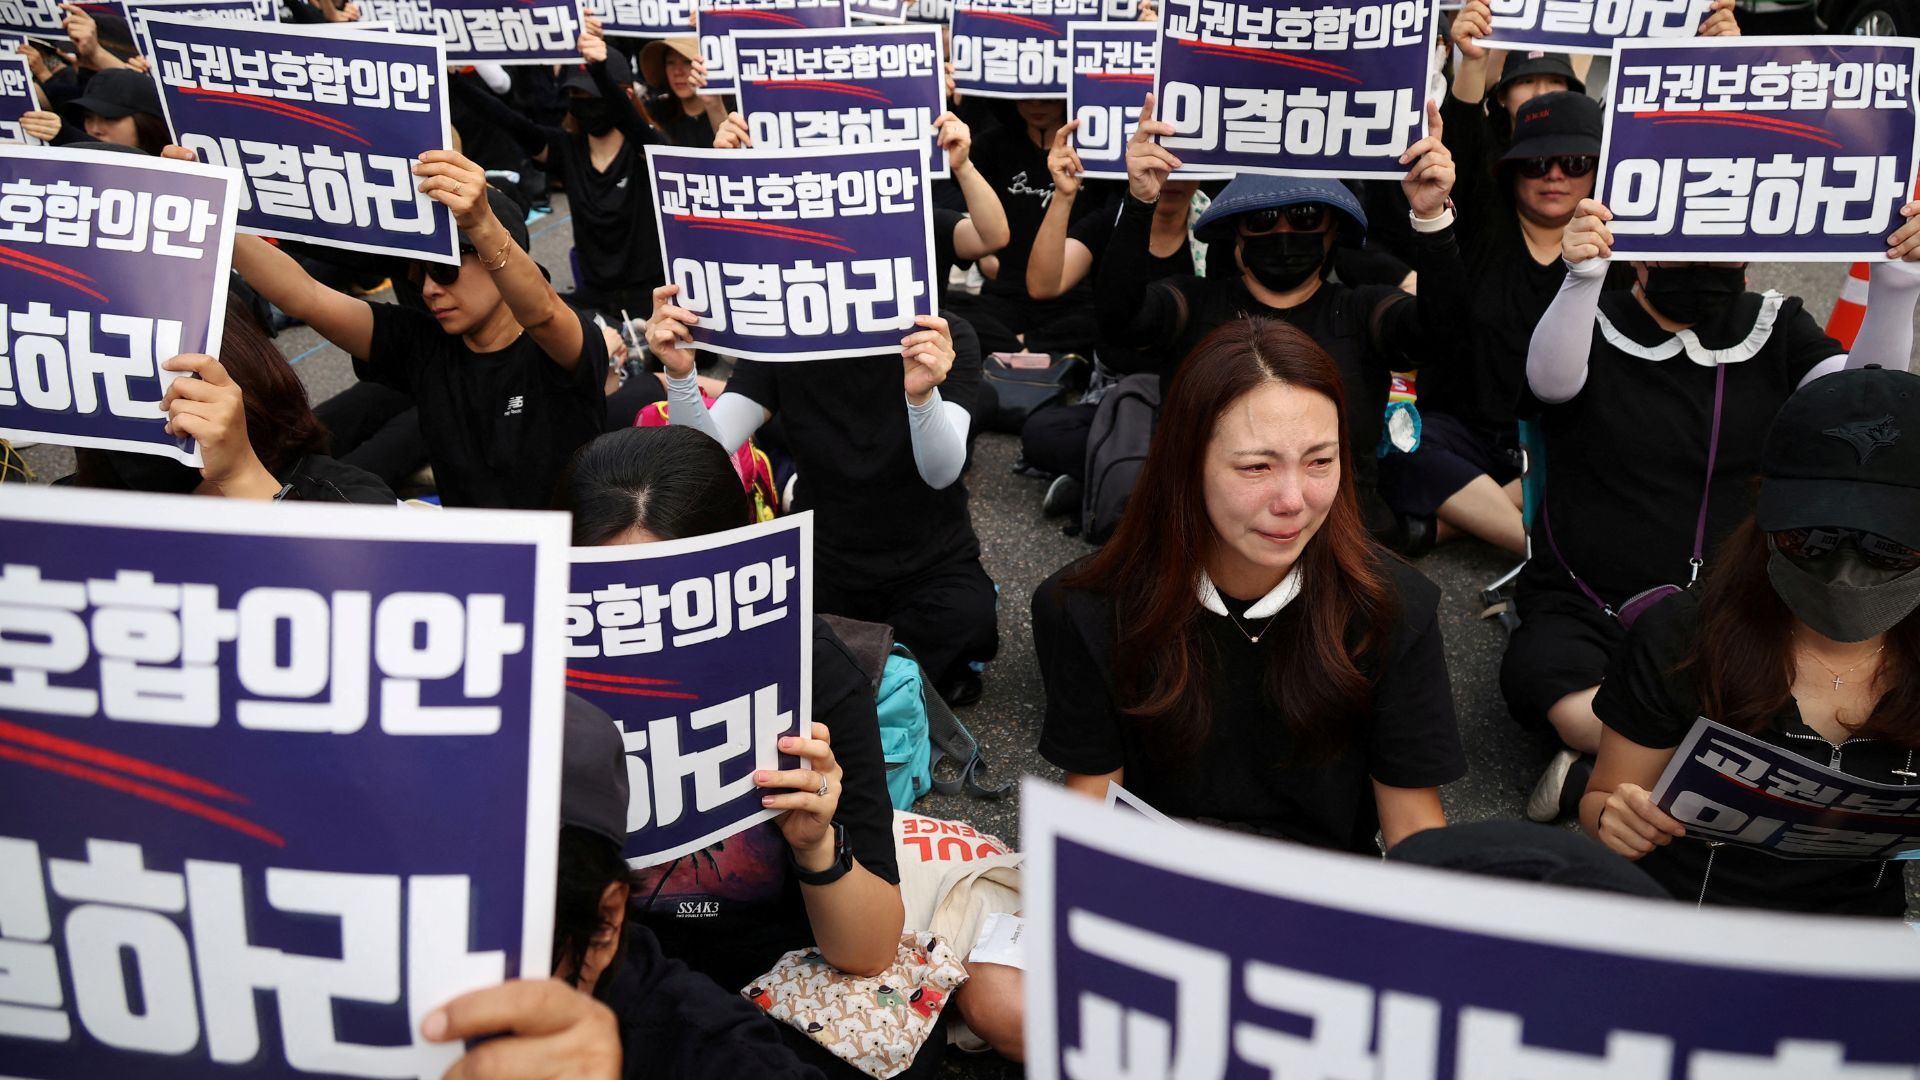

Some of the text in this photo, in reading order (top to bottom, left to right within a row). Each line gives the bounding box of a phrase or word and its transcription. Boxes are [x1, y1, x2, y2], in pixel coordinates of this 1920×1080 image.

[434, 5, 578, 53] 의결하라
[739, 43, 936, 83] 교권보호합의안
[1164, 0, 1428, 51] 교권보호합의안
[156, 39, 436, 113] 교권보호합의안
[1622, 60, 1912, 113] 교권보호합의안
[1160, 81, 1424, 158] 의결하라
[0, 178, 218, 260] 호합의안
[179, 132, 437, 236] 의결하라
[657, 166, 919, 220] 교권보호합의안
[1609, 155, 1906, 236] 의결하라
[675, 257, 925, 337] 의결하라
[0, 301, 194, 422] 하라
[0, 563, 525, 735] 호합의안
[1668, 790, 1920, 856] 의결
[677, 901, 719, 914] SSAK3
[1064, 907, 1920, 1080] 교권
